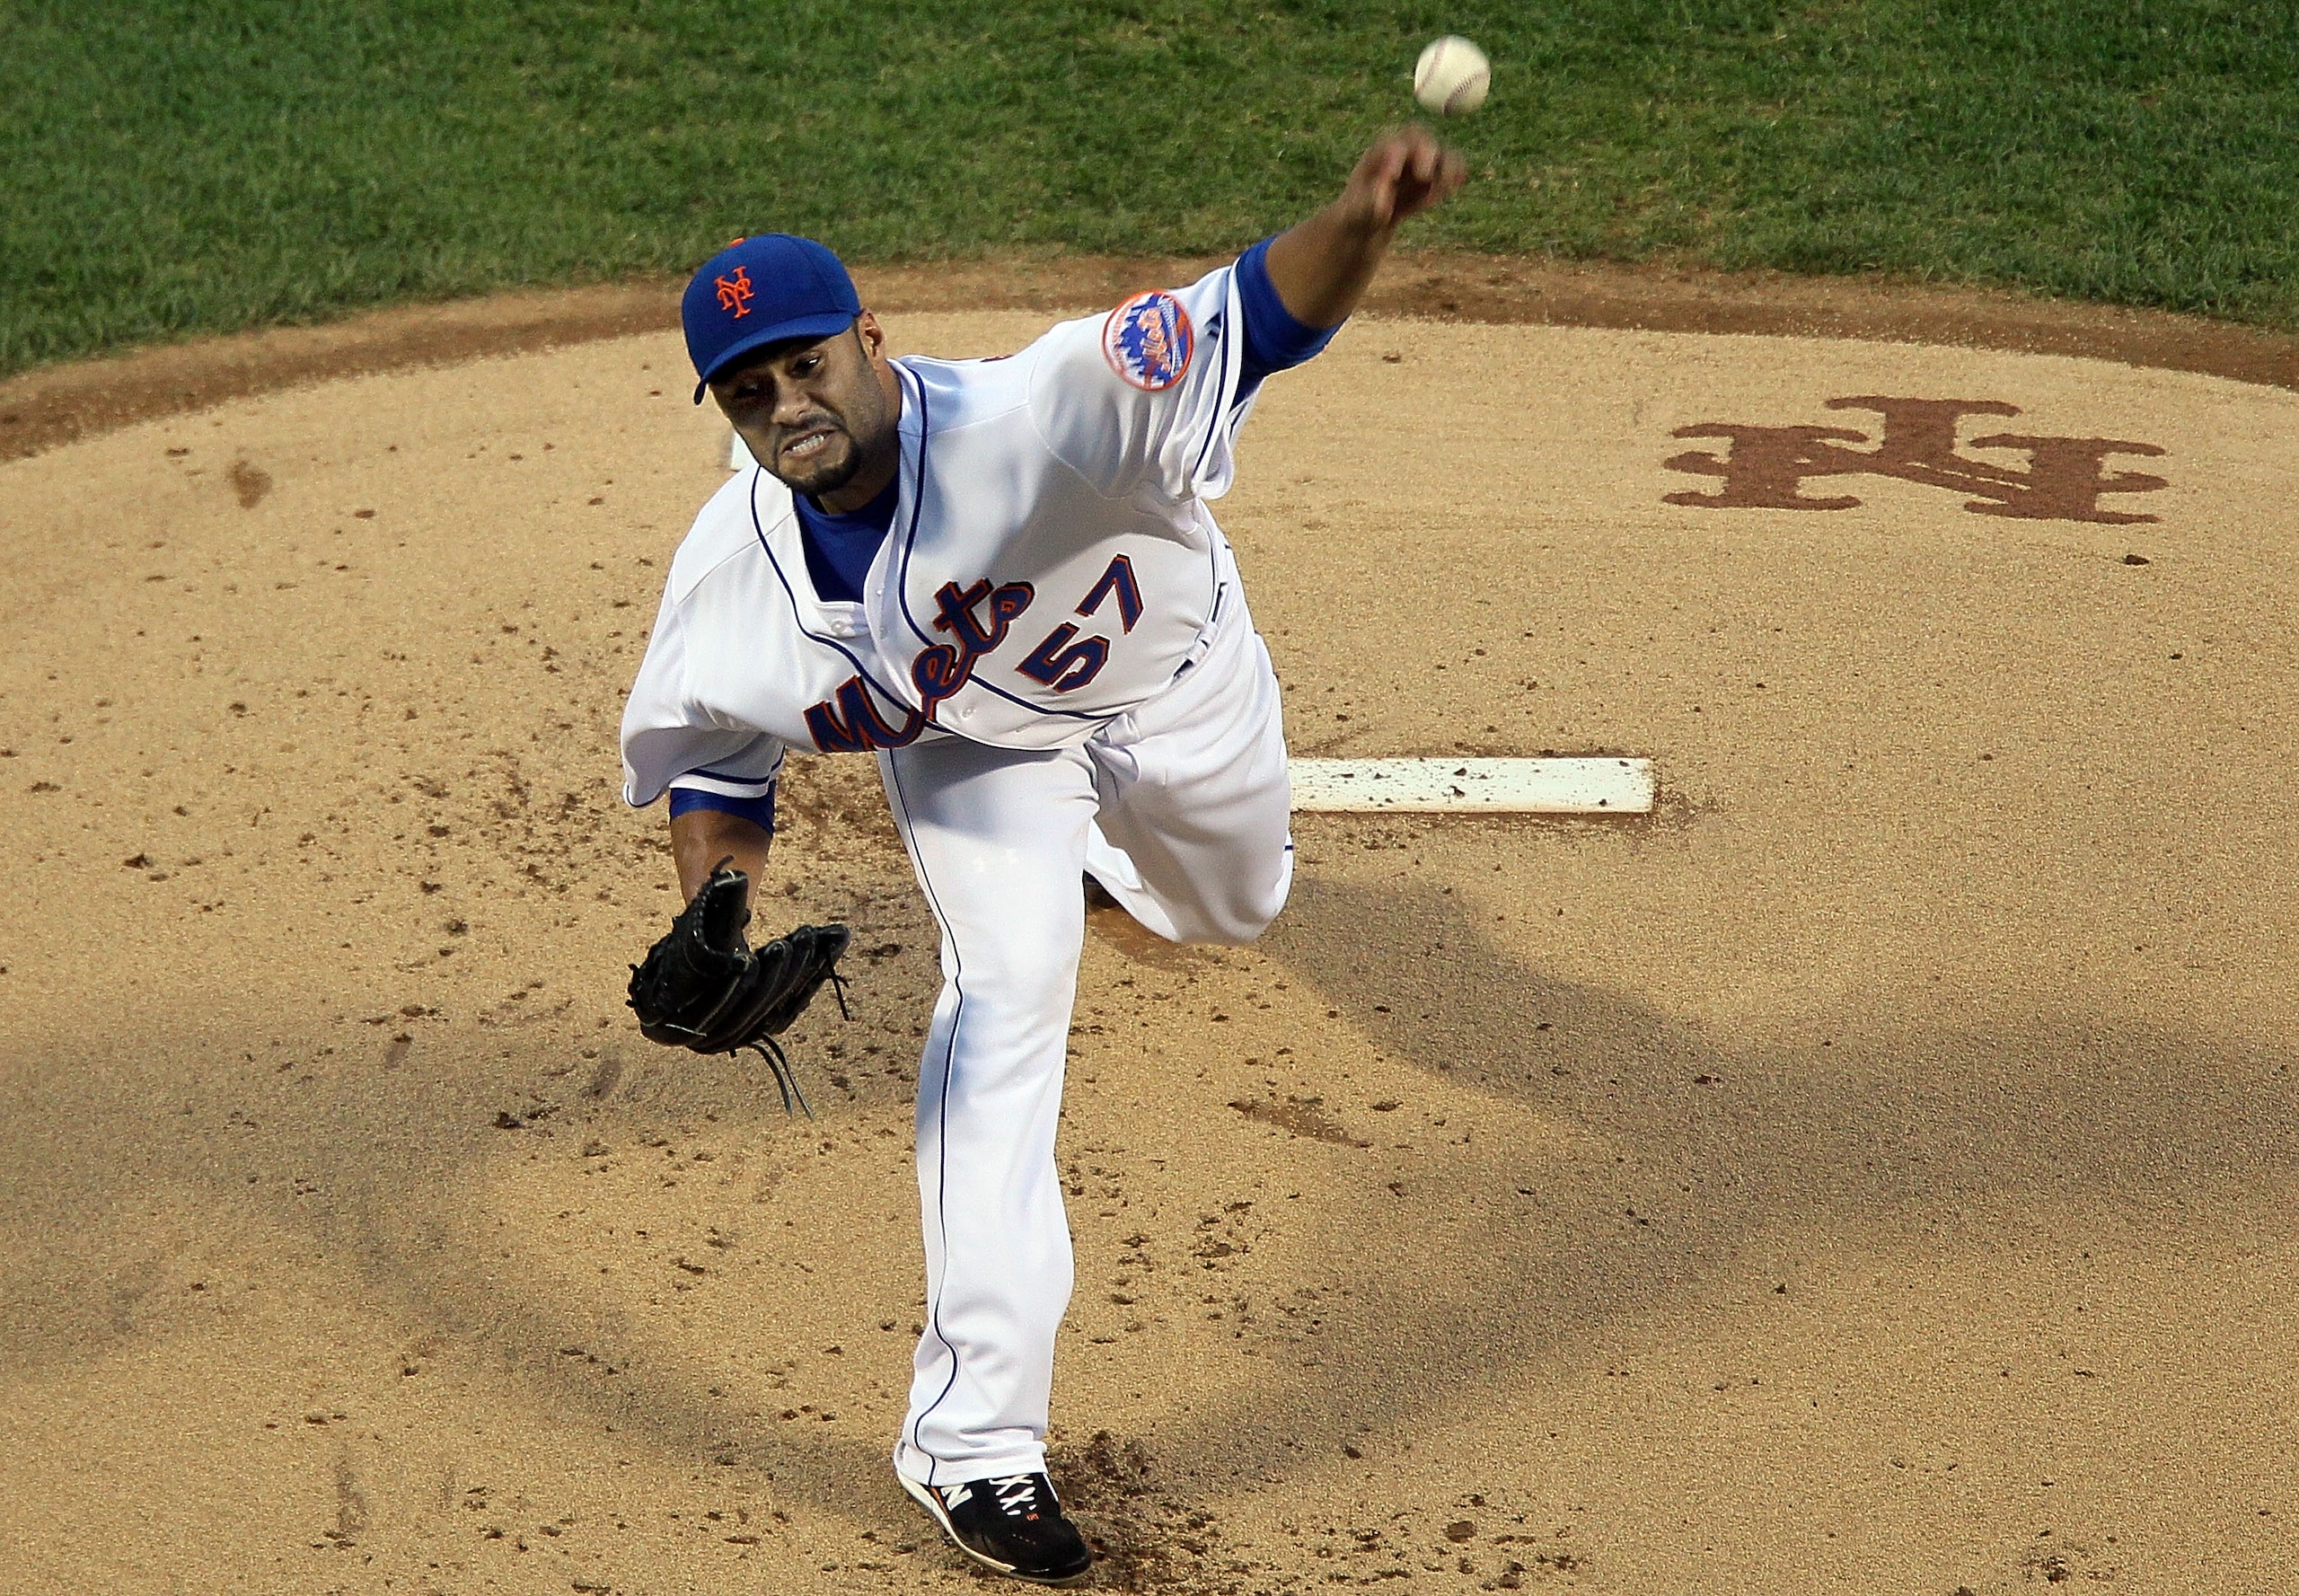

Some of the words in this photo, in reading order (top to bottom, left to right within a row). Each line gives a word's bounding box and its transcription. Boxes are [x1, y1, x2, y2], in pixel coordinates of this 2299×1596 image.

[713, 266, 755, 319] NY
[803, 578, 1035, 753] Mets
[1016, 553, 1144, 693] 57
